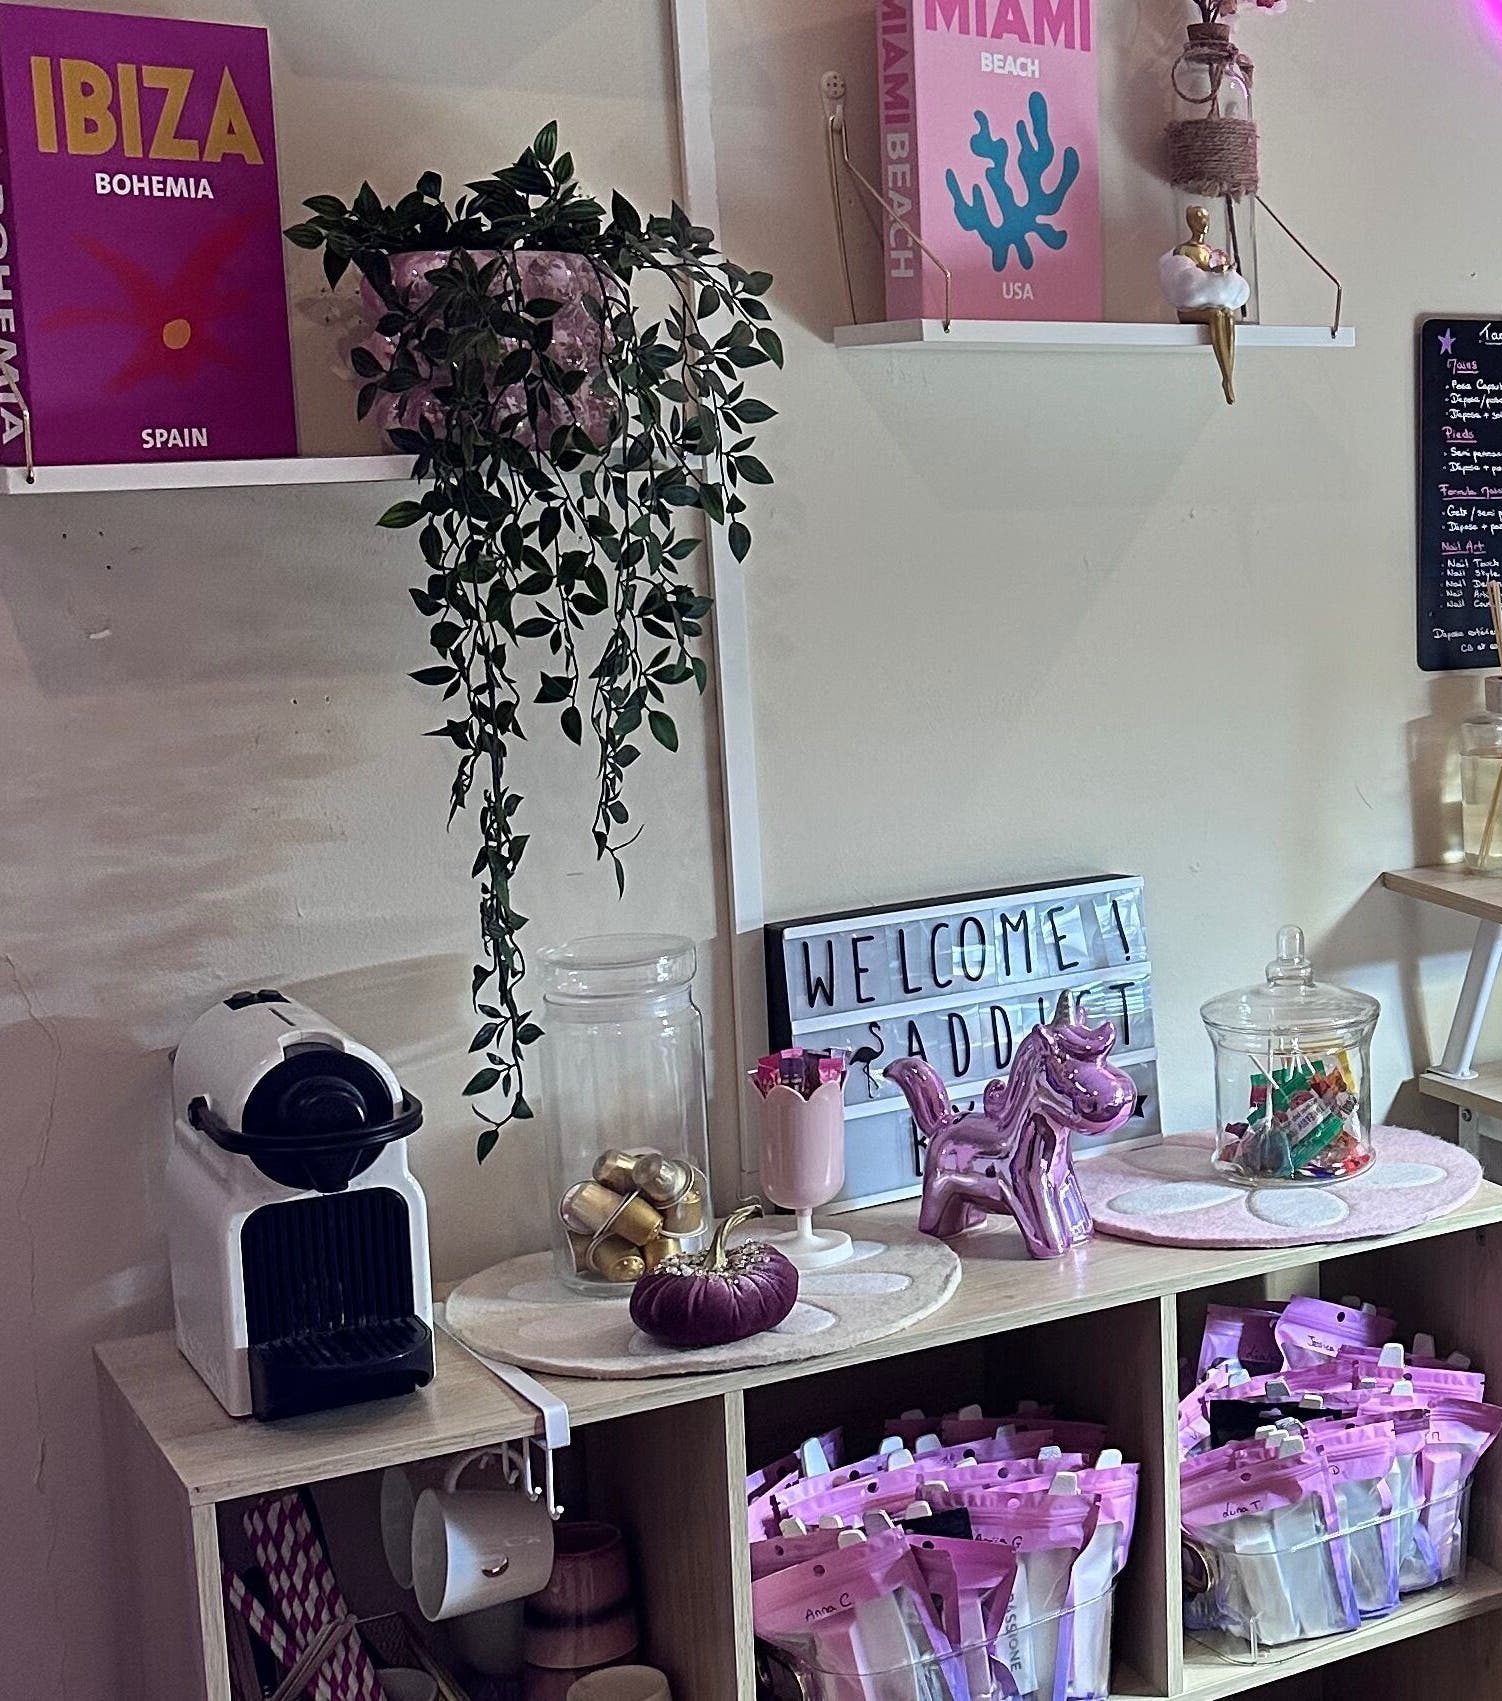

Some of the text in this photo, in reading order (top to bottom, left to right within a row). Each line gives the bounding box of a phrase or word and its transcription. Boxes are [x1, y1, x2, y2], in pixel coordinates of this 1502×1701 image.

[980, 51, 1040, 79] BEACH
[30, 54, 264, 166] IBIZA
[94, 171, 215, 200] BOHEMIA
[886, 132, 914, 278] BEACH
[1002, 281, 1034, 301] USA
[141, 426, 209, 450] SPAIN
[1442, 426, 1475, 440] Pieds
[802, 899, 1131, 1009] WELCOME !
[908, 981, 1135, 1078] ADDT
[805, 1592, 852, 1622] Anna C
